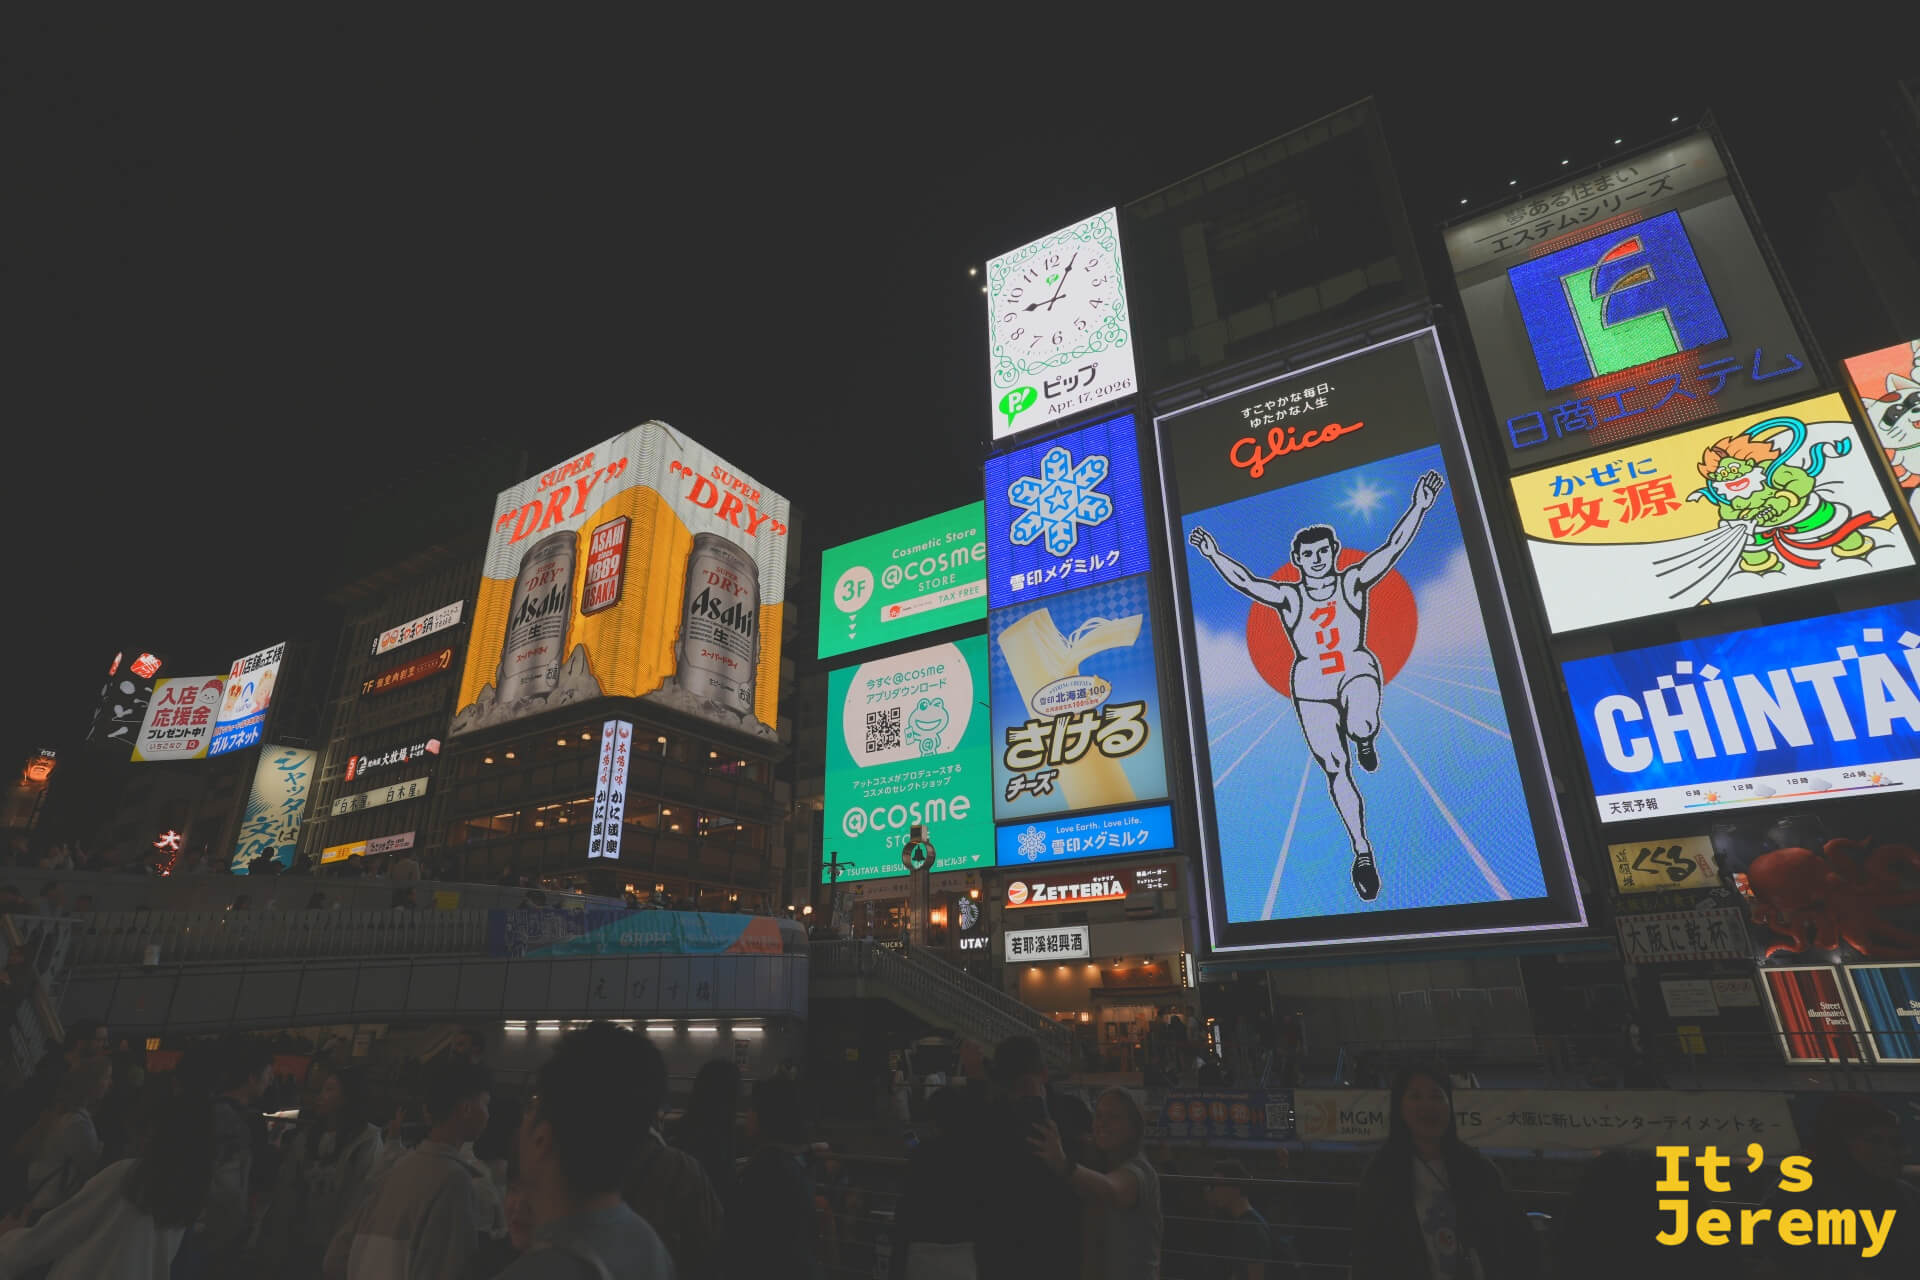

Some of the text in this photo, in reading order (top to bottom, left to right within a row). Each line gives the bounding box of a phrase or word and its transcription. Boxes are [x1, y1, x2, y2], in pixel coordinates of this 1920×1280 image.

[1492, 174, 1676, 255] エステムシリーズ
[1023, 268, 1039, 284] 11
[1042, 254, 1060, 272] 12
[1084, 258, 1100, 273] 2
[1007, 287, 1024, 305] 10
[1089, 297, 1104, 310] 4
[1010, 327, 1025, 341] 8
[1073, 317, 1087, 331] 5
[1030, 335, 1042, 349] 7
[1051, 330, 1064, 346] 6
[1043, 362, 1099, 399] ピップ
[1047, 398, 1075, 415] Apr.
[1095, 377, 1132, 398] 2026
[1240, 382, 1336, 419] すこやかな毎日、
[1505, 347, 1805, 449] 日商エステム
[1249, 397, 1329, 429] ゆたかな人生
[537, 452, 596, 493] SUPER
[710, 465, 762, 502] SUPER
[1548, 457, 1658, 498] かぜに
[1543, 474, 1683, 539] 改源
[591, 523, 625, 555] ASAHI
[892, 527, 977, 560] Cosmetic Store
[587, 554, 620, 584] 1889
[881, 542, 986, 589] @cosme
[1010, 549, 1120, 592] 雪印メグミルク
[583, 580, 616, 610] OSAKA
[841, 579, 867, 602] 3F
[918, 573, 957, 592] STORE
[938, 585, 980, 604] TAX FREE
[512, 583, 567, 632] Asahi
[691, 586, 753, 638] Asahi
[713, 628, 729, 646] 生
[1309, 600, 1346, 676] グリコ
[865, 663, 945, 691] 今すぐ@cosme
[157, 685, 199, 707] 入店
[865, 678, 947, 705] アプリダウンロード
[1594, 627, 1920, 775] CHINTA
[151, 705, 212, 728] 応援金
[1004, 700, 1149, 772] さける
[863, 776, 952, 799] コスメのセレクトショップ
[1005, 769, 1059, 803] チーズ
[1732, 783, 1754, 792] 12時
[1787, 777, 1809, 786] 18時
[1842, 770, 1867, 779] 24時
[386, 784, 417, 803] 白木屋
[1609, 798, 1659, 816] 天気予報
[1685, 789, 1701, 798] 6時
[842, 794, 971, 838] @cosme
[1056, 816, 1143, 834] Love Earth. Love Life.
[1051, 829, 1150, 856] 雪印メグミルク
[1631, 845, 1697, 882] くくる
[1031, 880, 1125, 902] ZETTERIA
[1339, 1111, 1384, 1125] MGM
